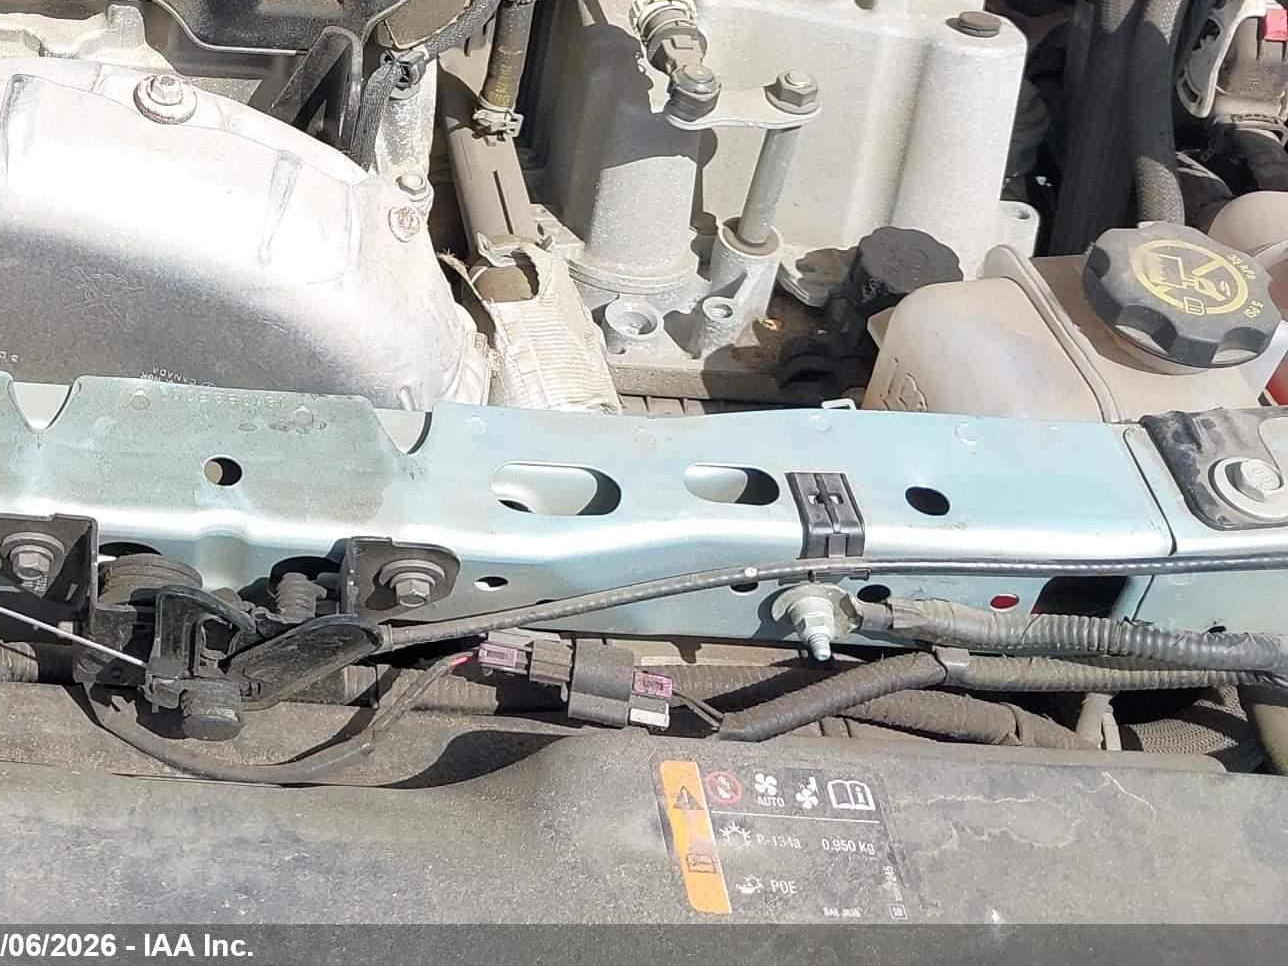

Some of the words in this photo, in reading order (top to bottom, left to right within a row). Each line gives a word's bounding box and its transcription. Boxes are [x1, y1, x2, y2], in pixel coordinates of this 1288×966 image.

[152, 365, 196, 386] CANADA
[757, 796, 785, 808] AUTO
[821, 838, 856, 853] 0.950
[857, 839, 875, 856] kg
[770, 880, 798, 895] POE
